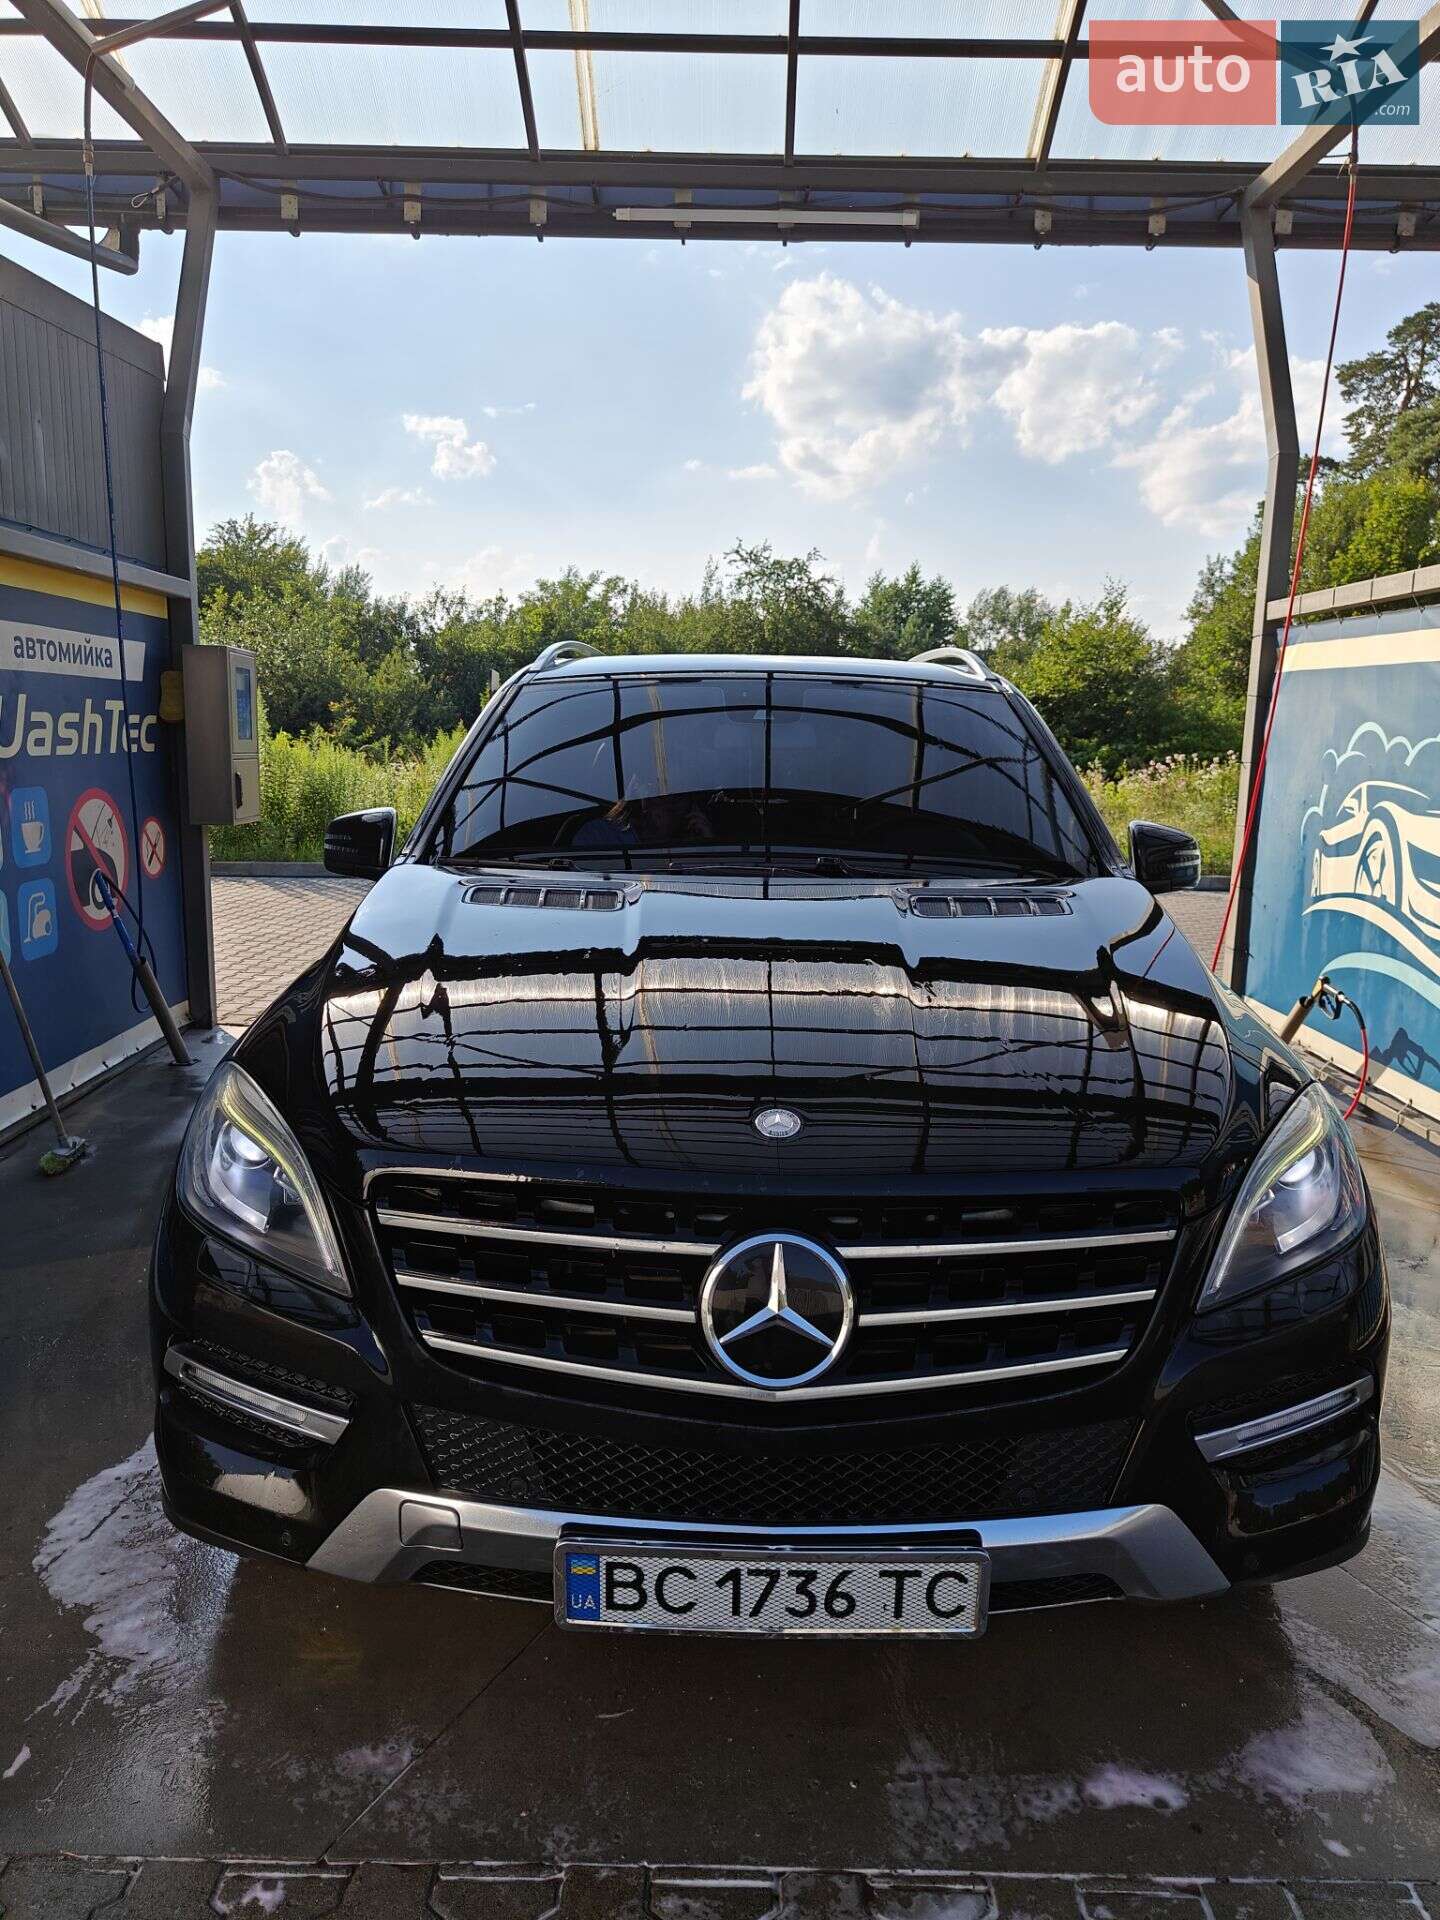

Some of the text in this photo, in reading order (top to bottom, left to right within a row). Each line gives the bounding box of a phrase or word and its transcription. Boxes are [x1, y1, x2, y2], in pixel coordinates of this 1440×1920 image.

[13, 634, 113, 669] автомийка
[571, 1593, 597, 1610] UA
[605, 1561, 969, 1619] BC 1736 TC
